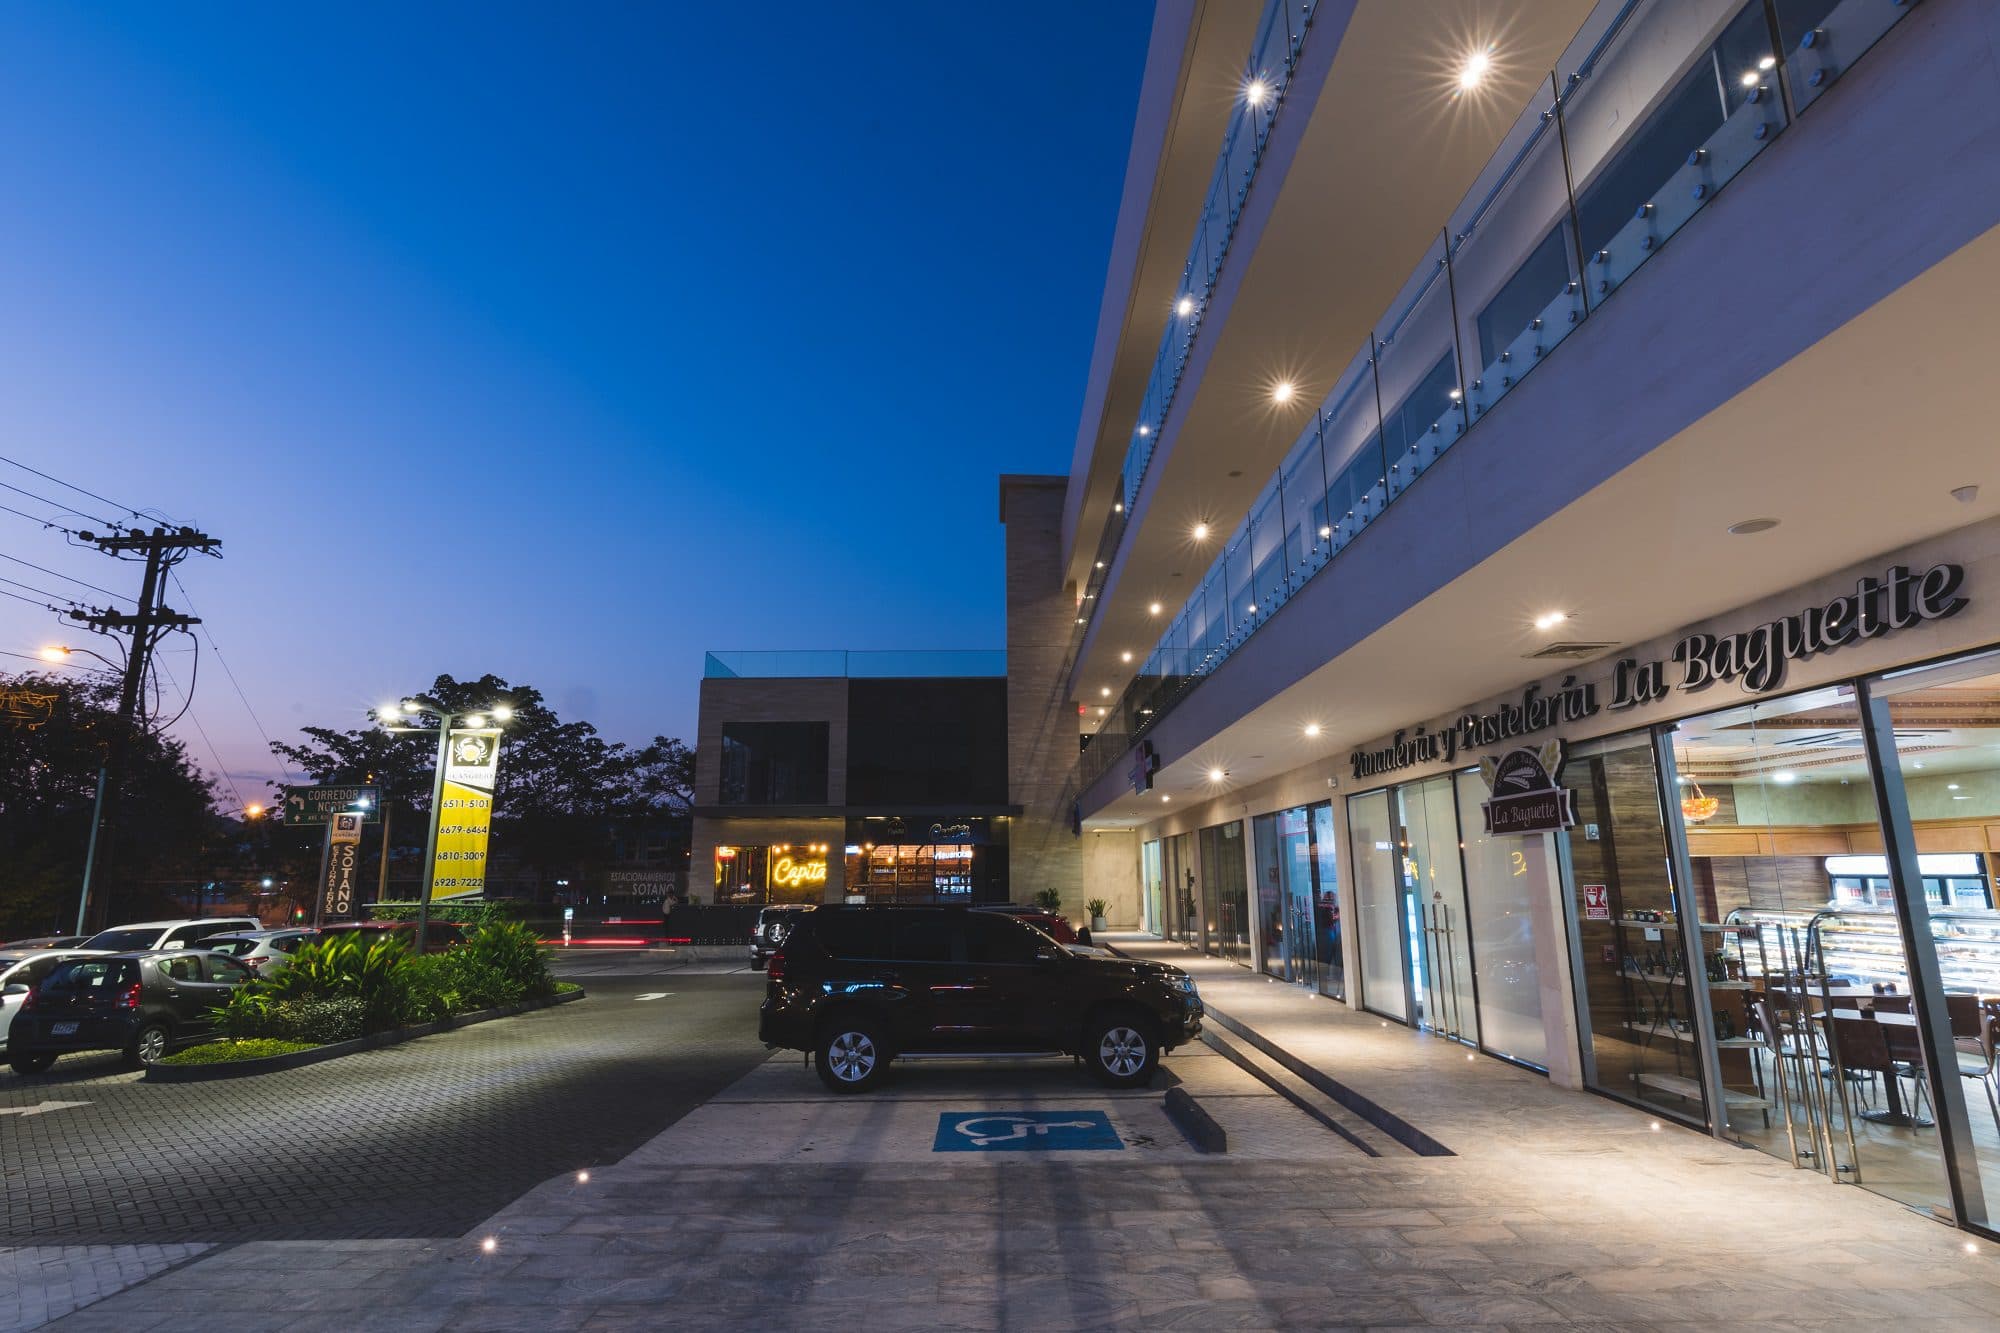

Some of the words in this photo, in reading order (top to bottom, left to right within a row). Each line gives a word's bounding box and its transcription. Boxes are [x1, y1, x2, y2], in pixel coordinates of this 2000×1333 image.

[1350, 726, 1441, 780] Panadería
[1438, 724, 1457, 763] y
[1456, 676, 1601, 751] Pastelería
[1606, 657, 1671, 711] La
[1672, 563, 1970, 694] Baguette
[308, 789, 359, 801] CORREDOR
[443, 799, 490, 808] 6511-5101
[1495, 805, 1509, 825] La
[1511, 801, 1556, 827] Baguette
[440, 825, 487, 834] 6679-6464
[437, 851, 484, 860] 6810-3009
[336, 845, 355, 913] SOTANO
[434, 878, 483, 887] 6928-7222
[631, 883, 675, 896] SOTANO
